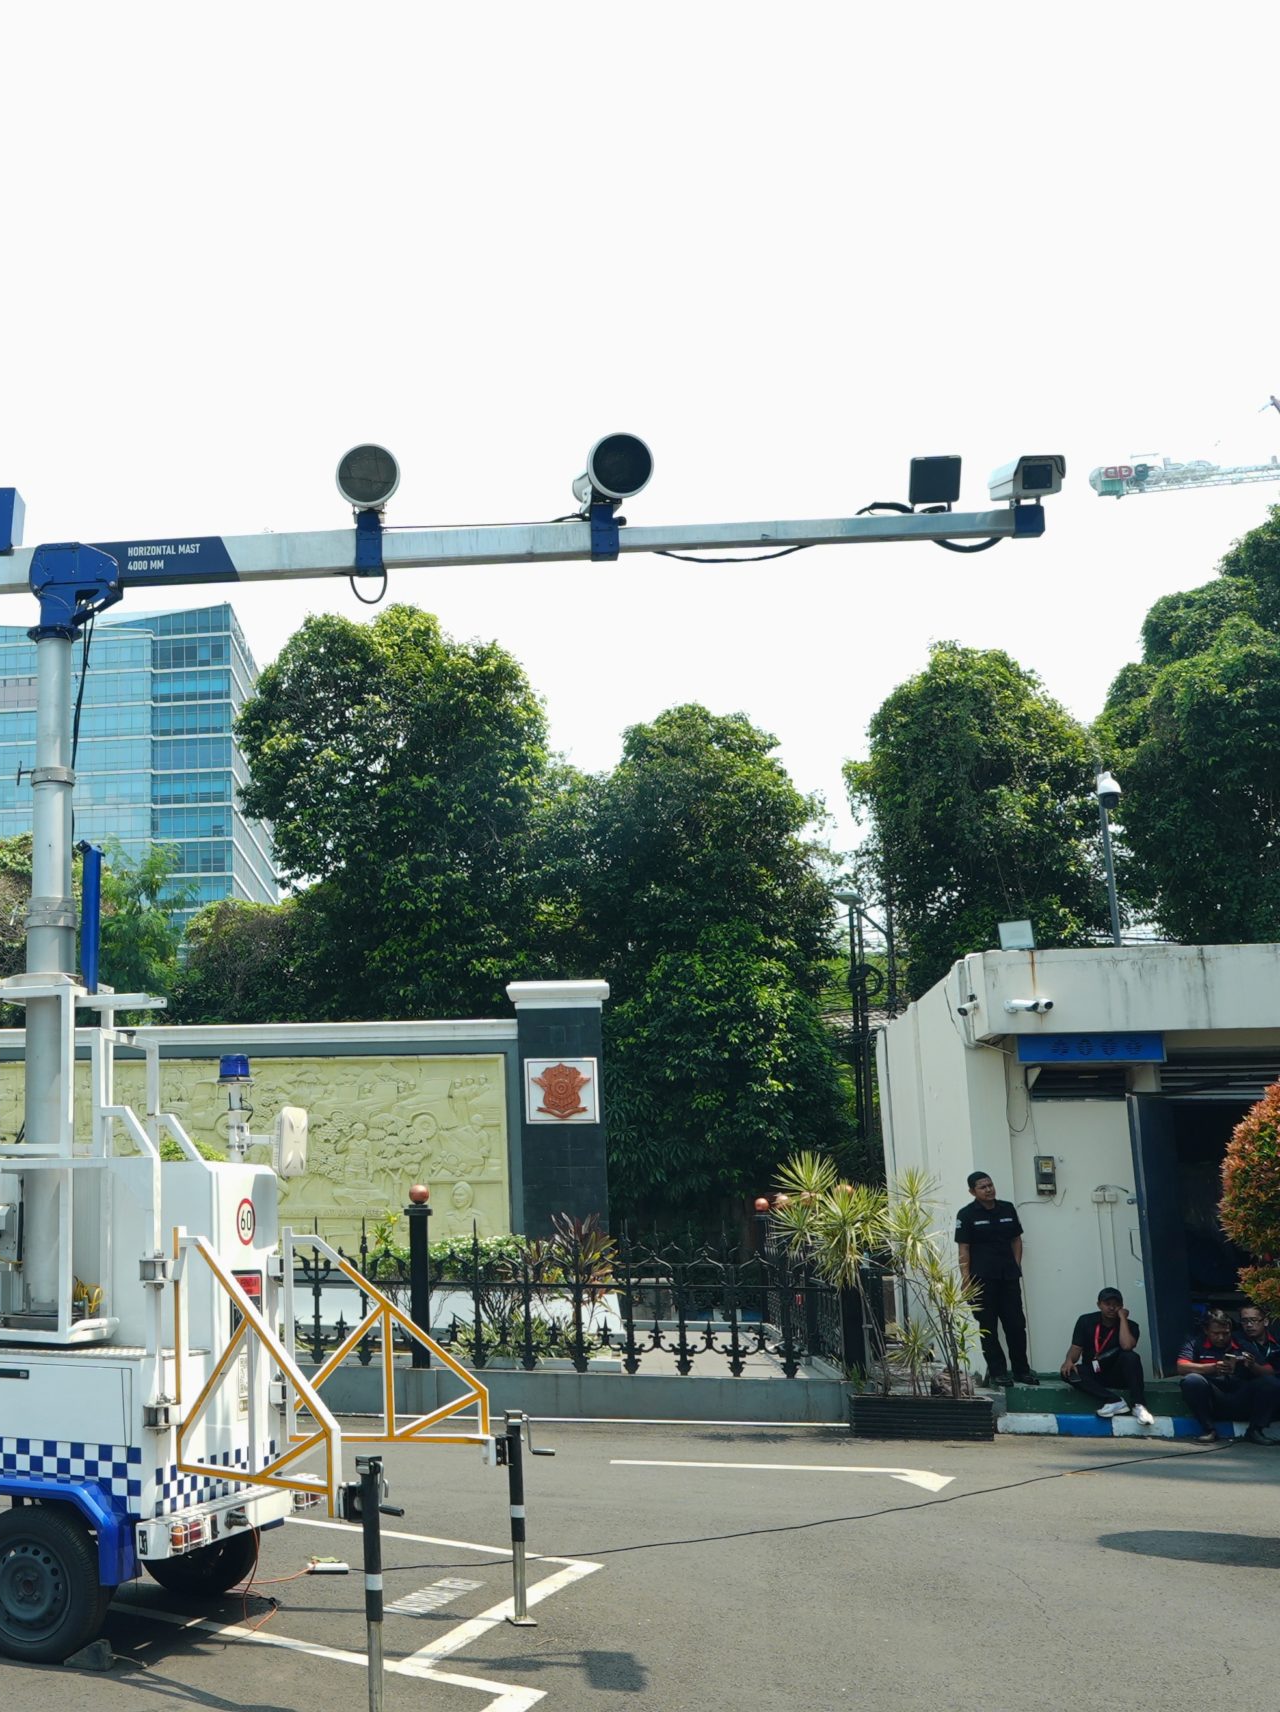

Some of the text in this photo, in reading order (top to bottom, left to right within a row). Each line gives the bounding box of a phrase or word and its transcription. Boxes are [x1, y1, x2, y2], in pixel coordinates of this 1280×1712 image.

[127, 543, 201, 557] HORIZONTAL MAST
[127, 559, 165, 571] 4000 MM
[240, 1210, 251, 1231] 60
